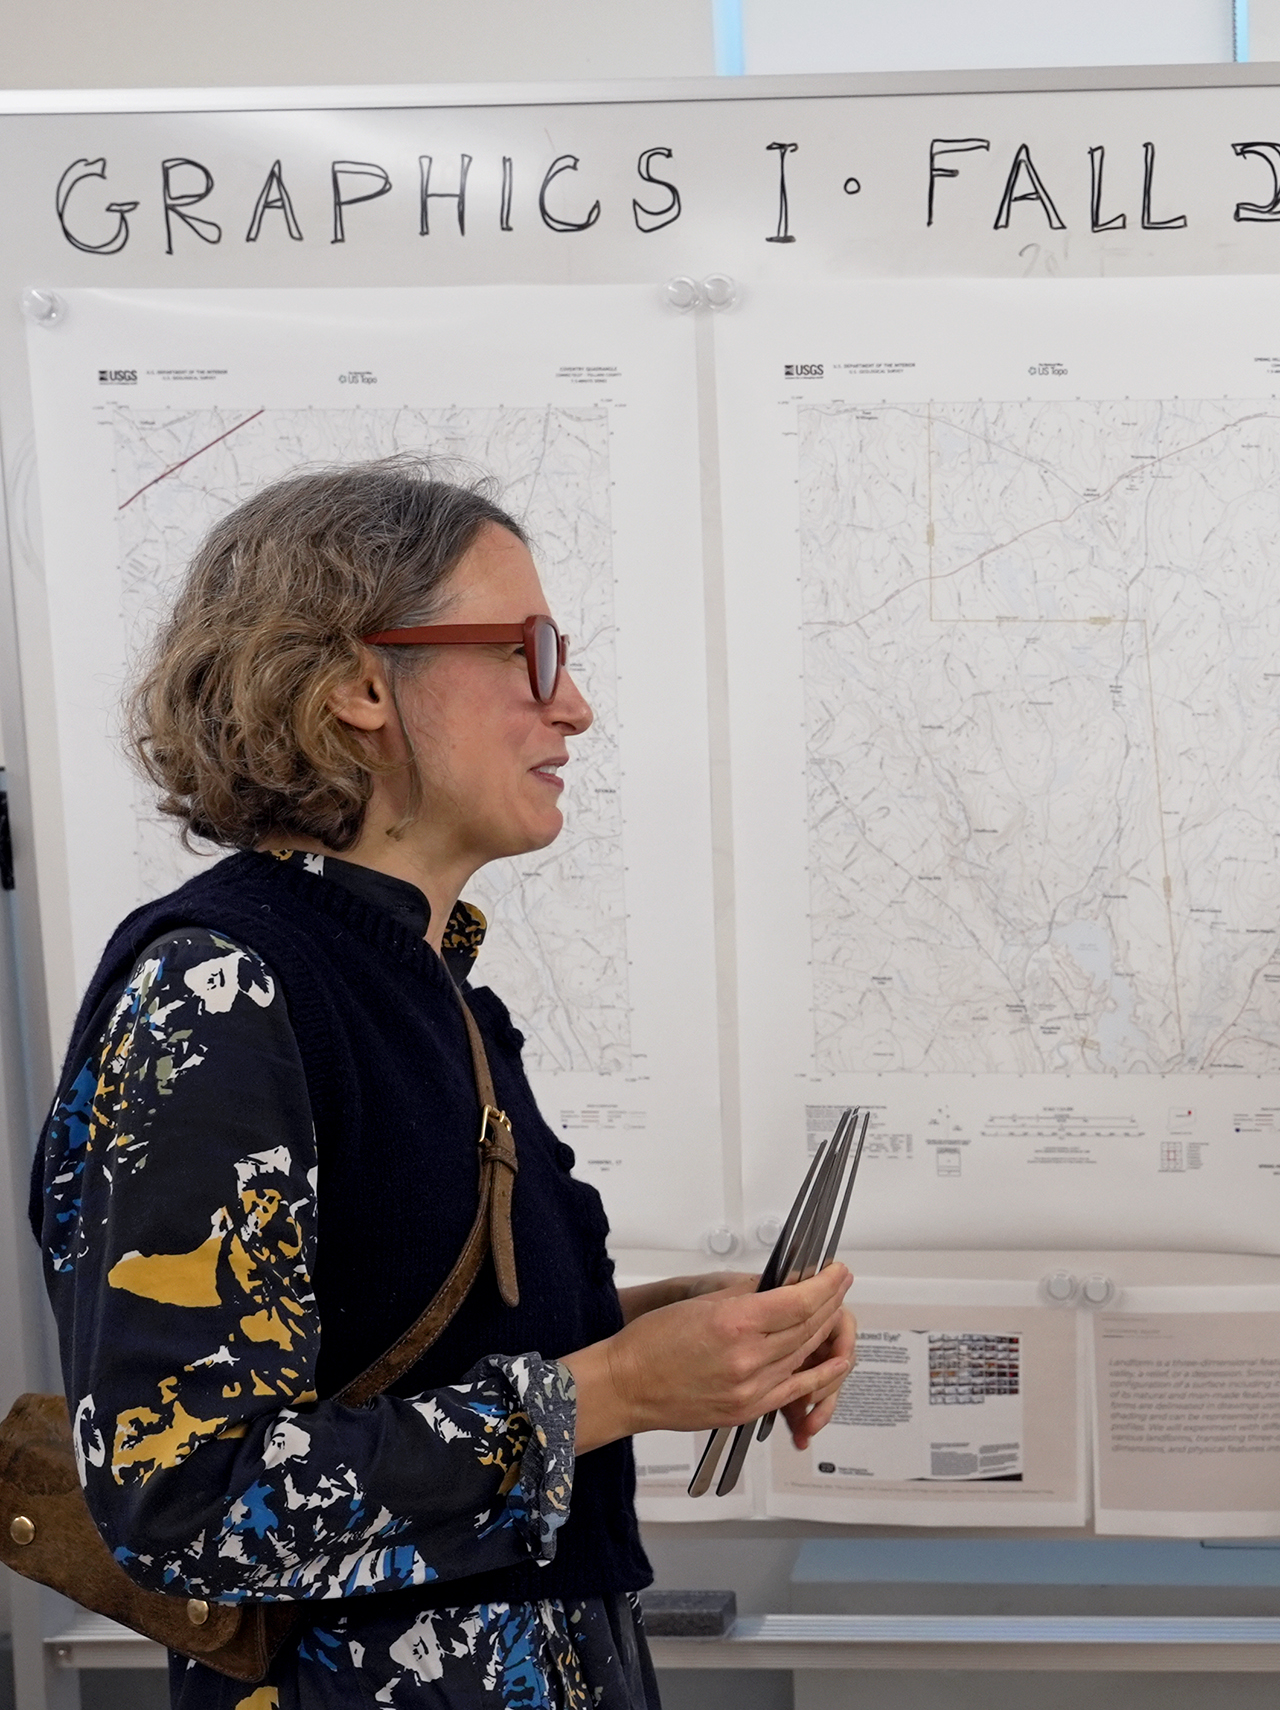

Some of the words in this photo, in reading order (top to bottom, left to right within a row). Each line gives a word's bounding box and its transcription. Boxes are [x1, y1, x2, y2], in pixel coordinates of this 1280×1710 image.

[55, 147, 682, 255] GRAPHICS
[926, 138, 1188, 233] FALL
[110, 370, 138, 382] USGS
[796, 364, 824, 376] USGS
